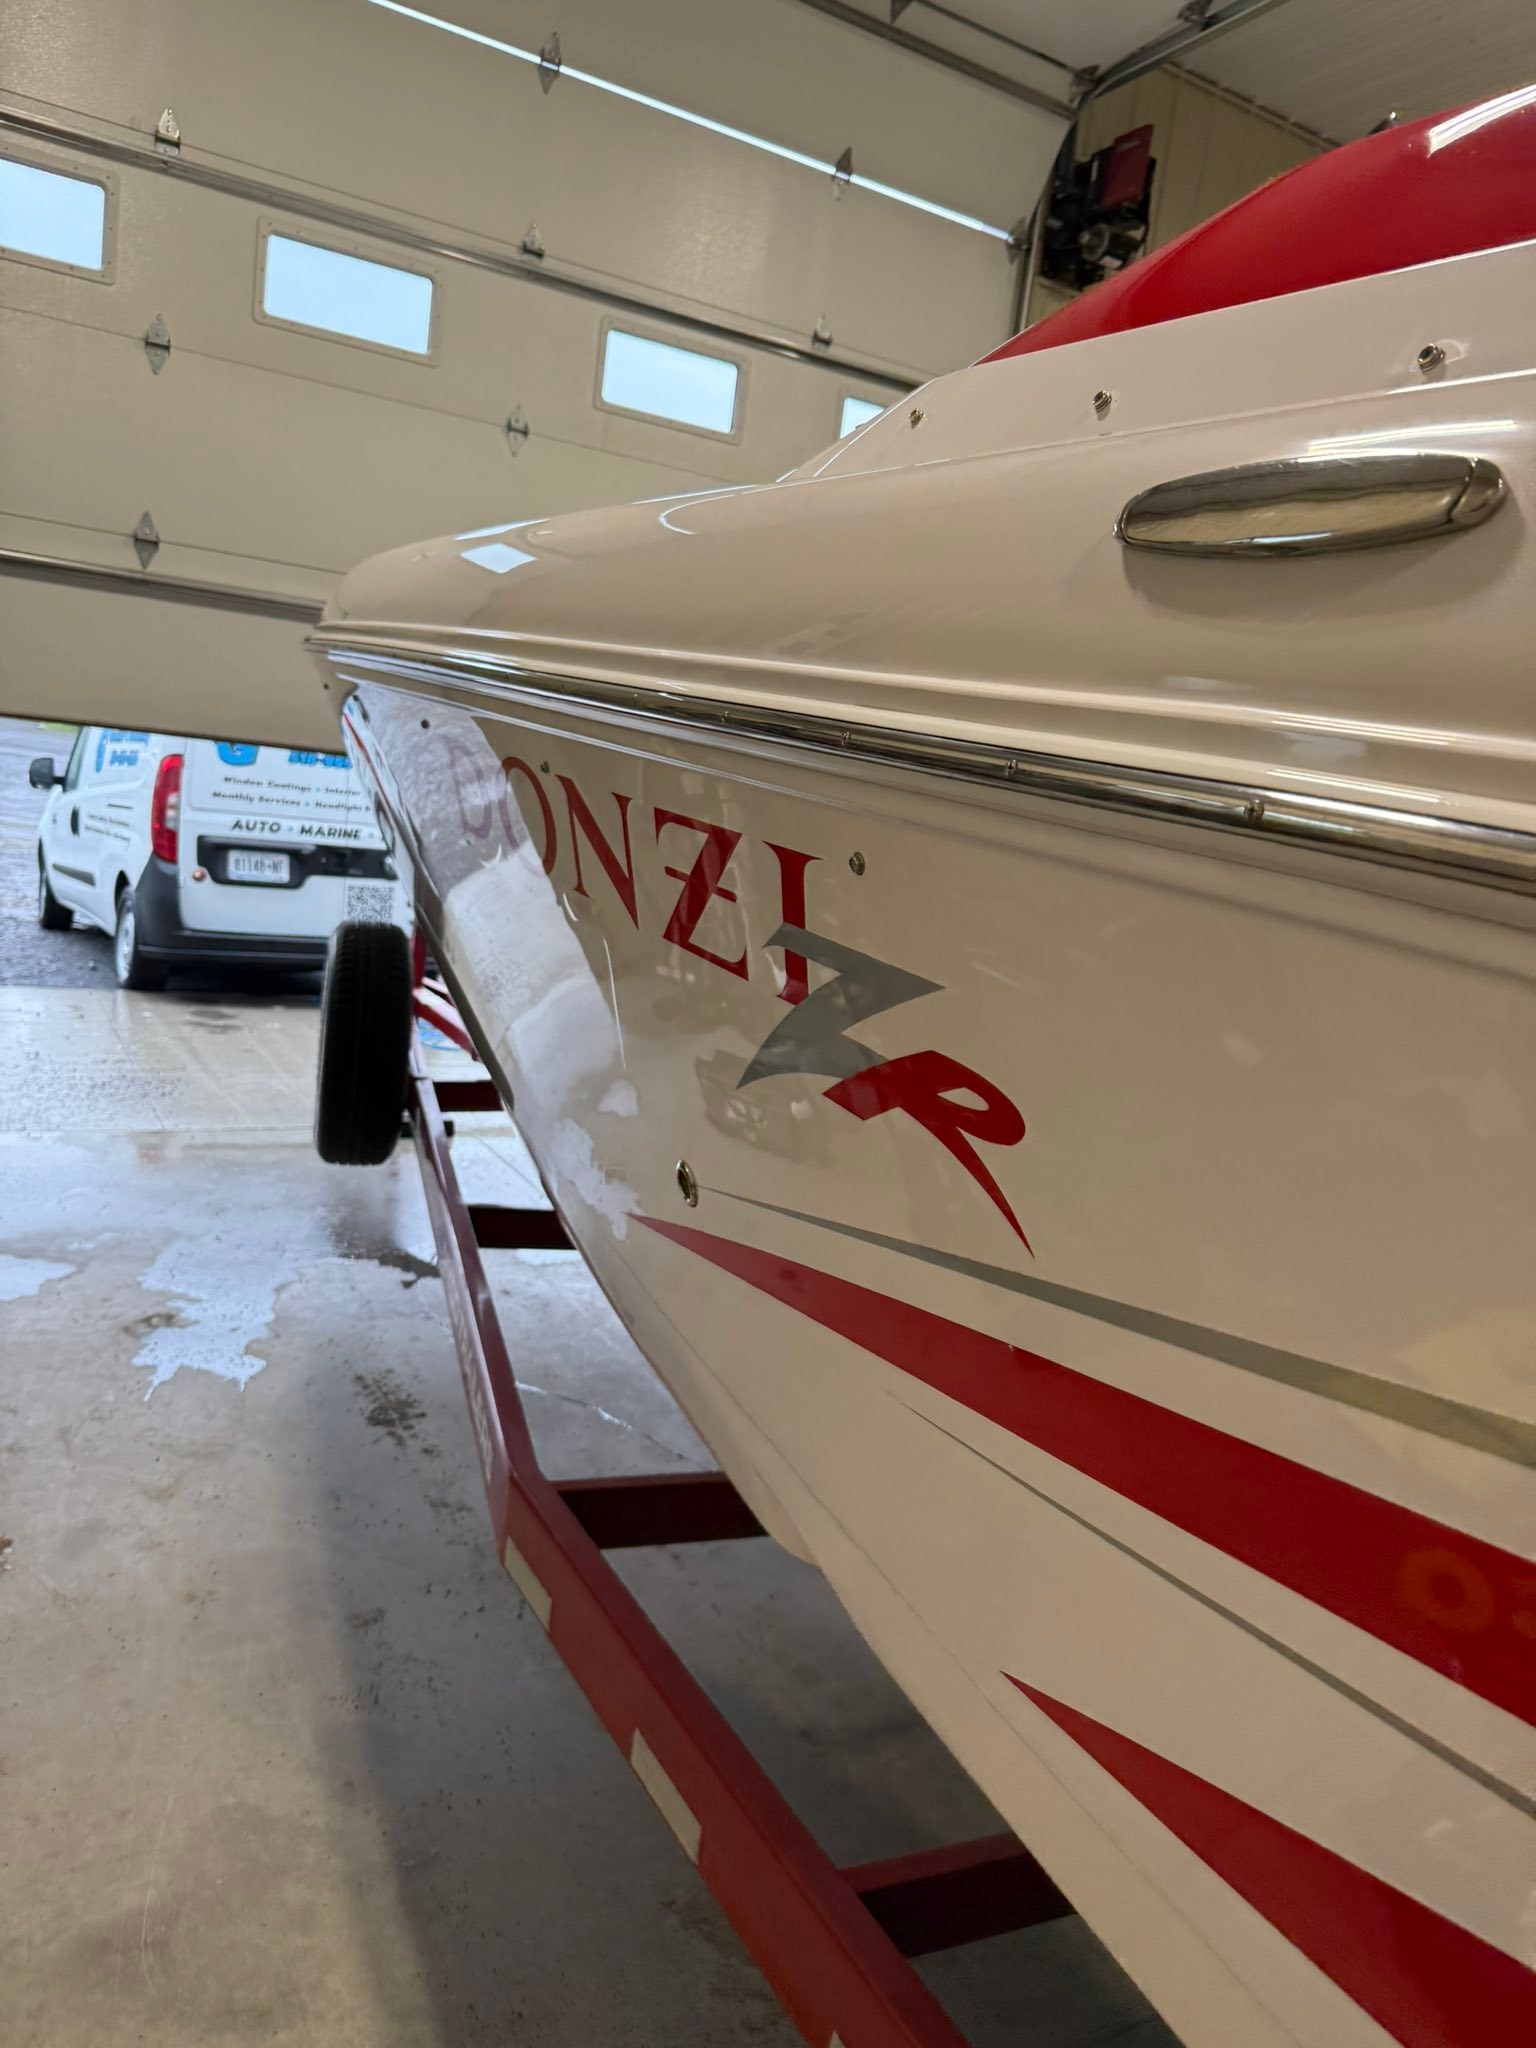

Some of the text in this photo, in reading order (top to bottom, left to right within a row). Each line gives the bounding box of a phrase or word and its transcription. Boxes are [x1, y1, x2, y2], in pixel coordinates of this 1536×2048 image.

[224, 776, 362, 797] Window Coatings Interior
[212, 790, 255, 804] Monthly
[259, 796, 301, 807] Services
[315, 801, 363, 813] Headlight
[231, 819, 363, 839] AUTO MARINE
